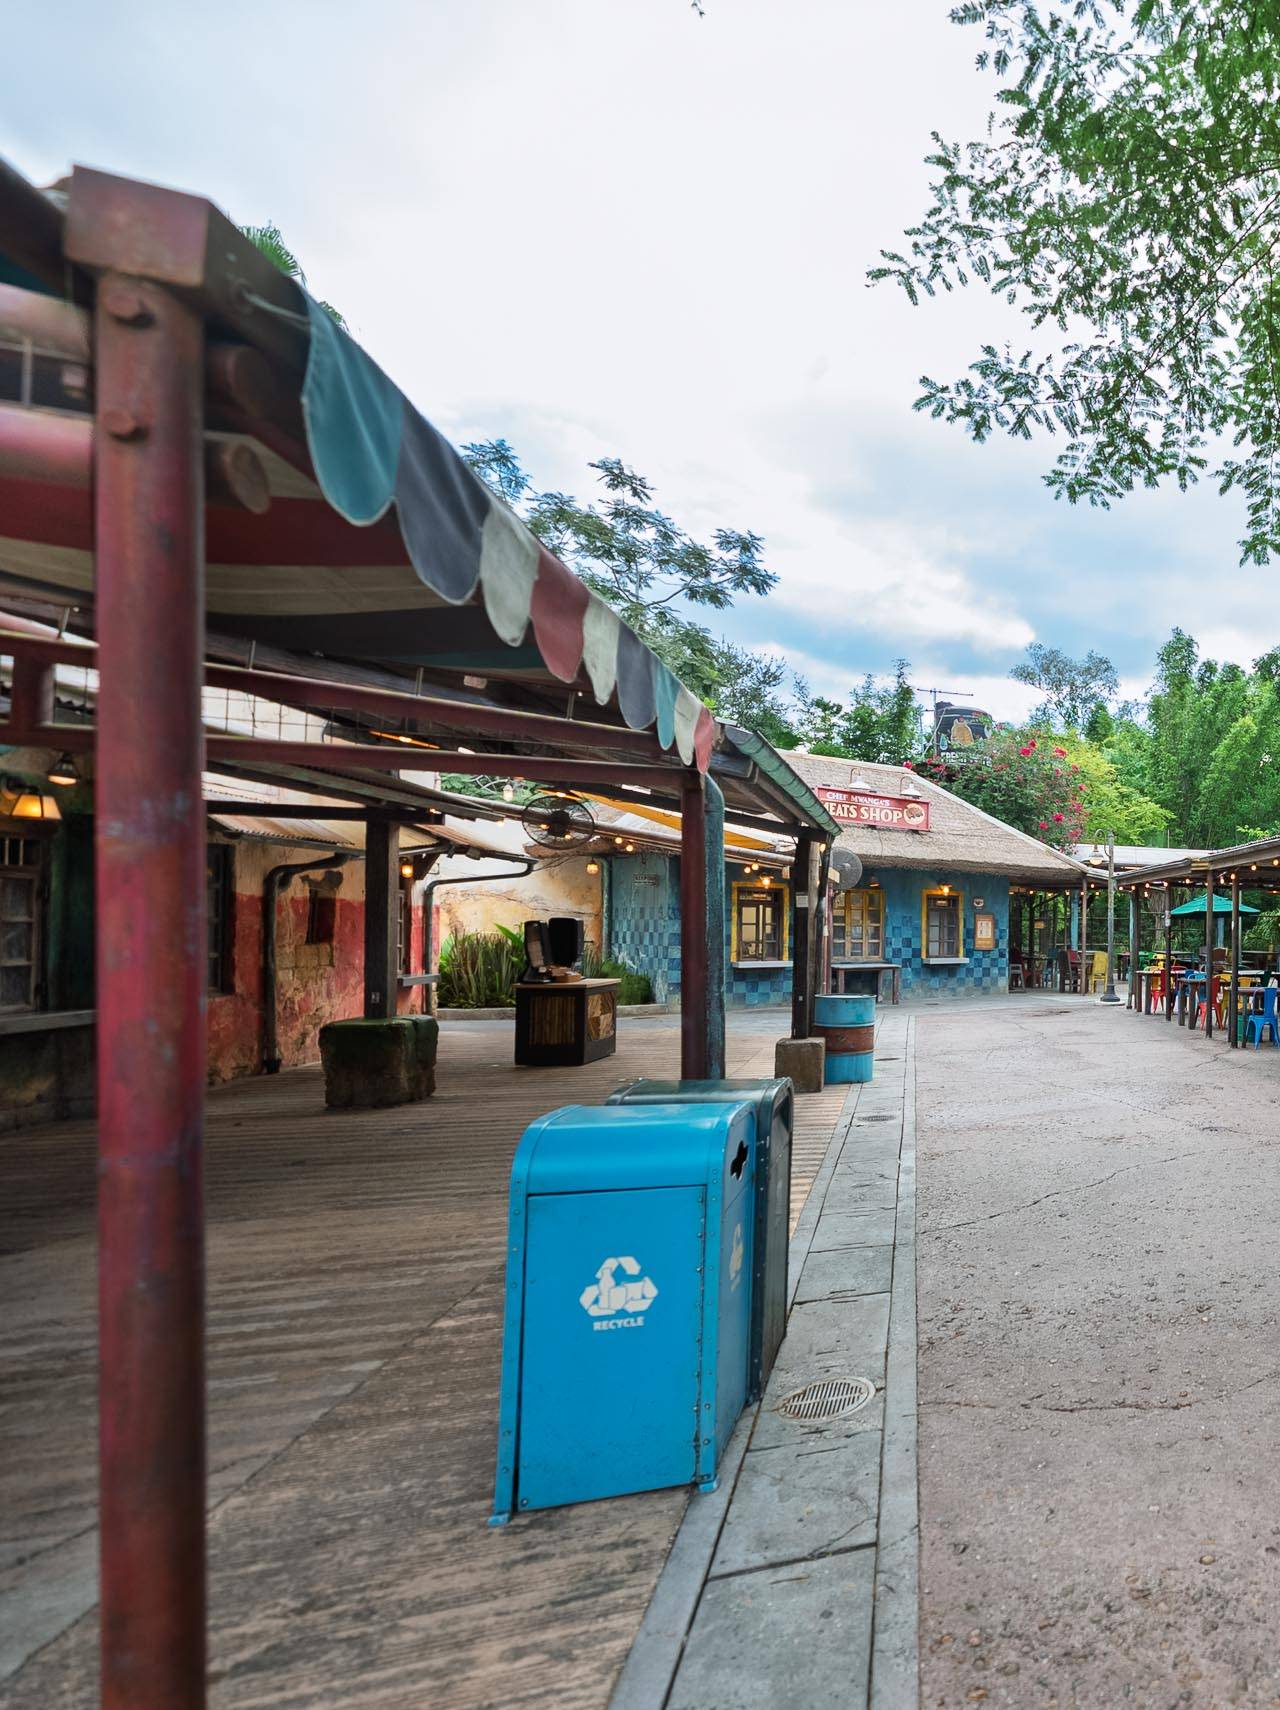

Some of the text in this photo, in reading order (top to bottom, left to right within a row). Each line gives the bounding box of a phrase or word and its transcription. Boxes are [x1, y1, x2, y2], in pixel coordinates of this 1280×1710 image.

[826, 791, 848, 800] CHEF
[860, 806, 902, 823] SHOP
[593, 1316, 645, 1331] RECYCLE
